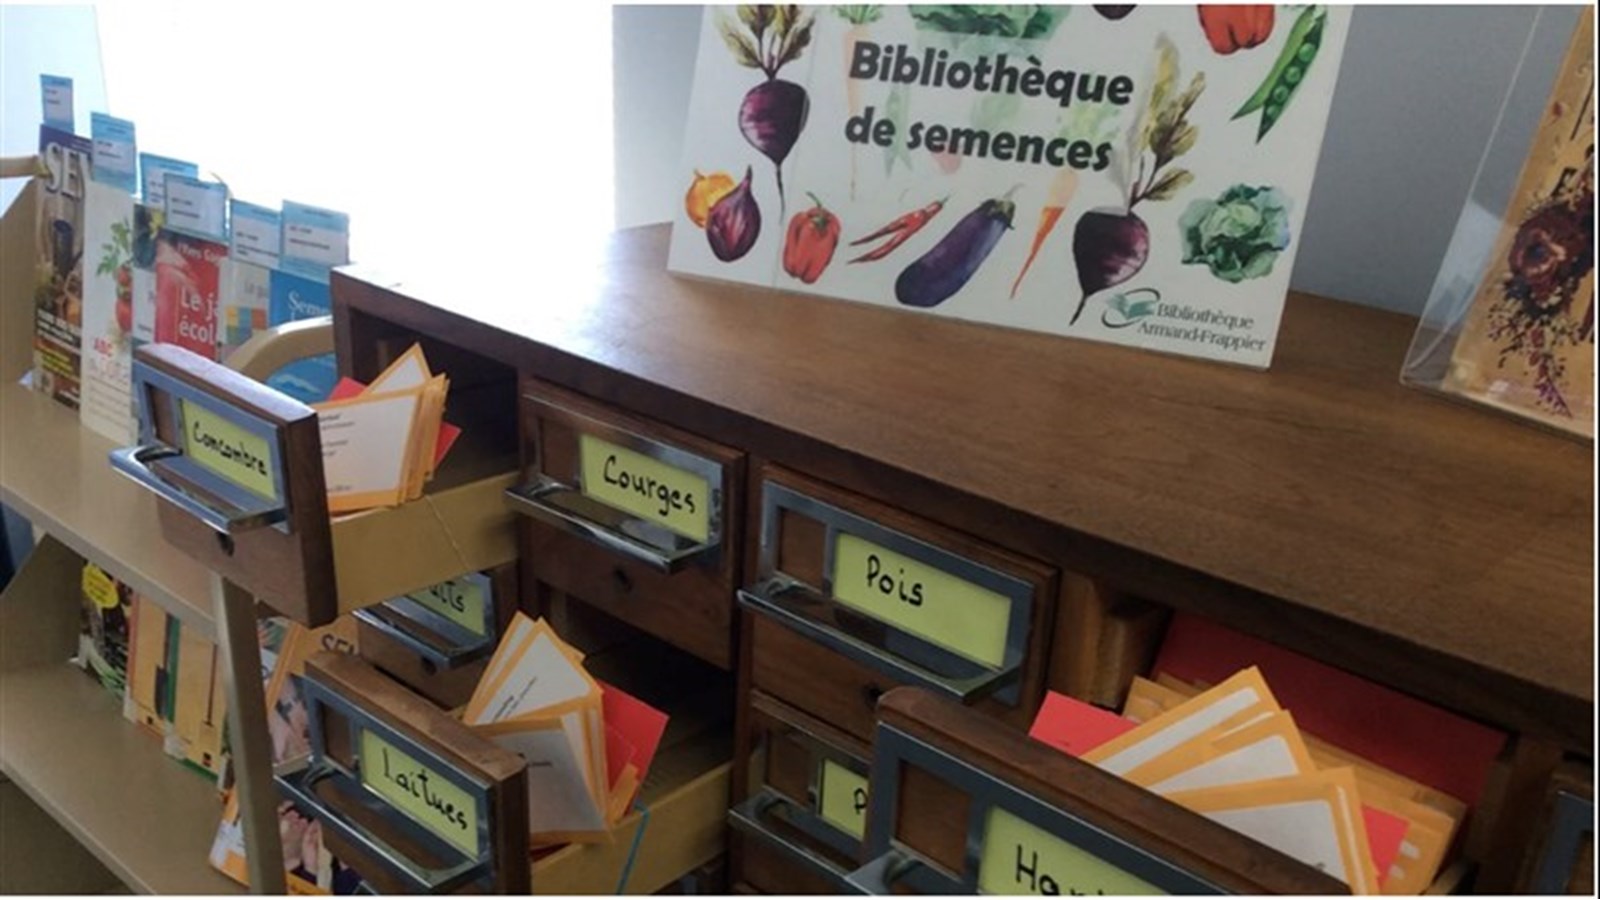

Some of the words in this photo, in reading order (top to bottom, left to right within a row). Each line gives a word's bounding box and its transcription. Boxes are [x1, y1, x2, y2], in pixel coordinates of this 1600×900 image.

[848, 41, 1134, 107] Bibliothèque
[845, 106, 896, 147] de
[906, 121, 1113, 172] semences
[181, 286, 201, 312] Le
[1156, 303, 1255, 330] Bibliothèque
[1137, 321, 1267, 351] Armand-Frappier
[193, 420, 268, 477] Concombre
[602, 455, 696, 516] Courges
[867, 554, 923, 607] Pois
[383, 747, 467, 831] Laitues
